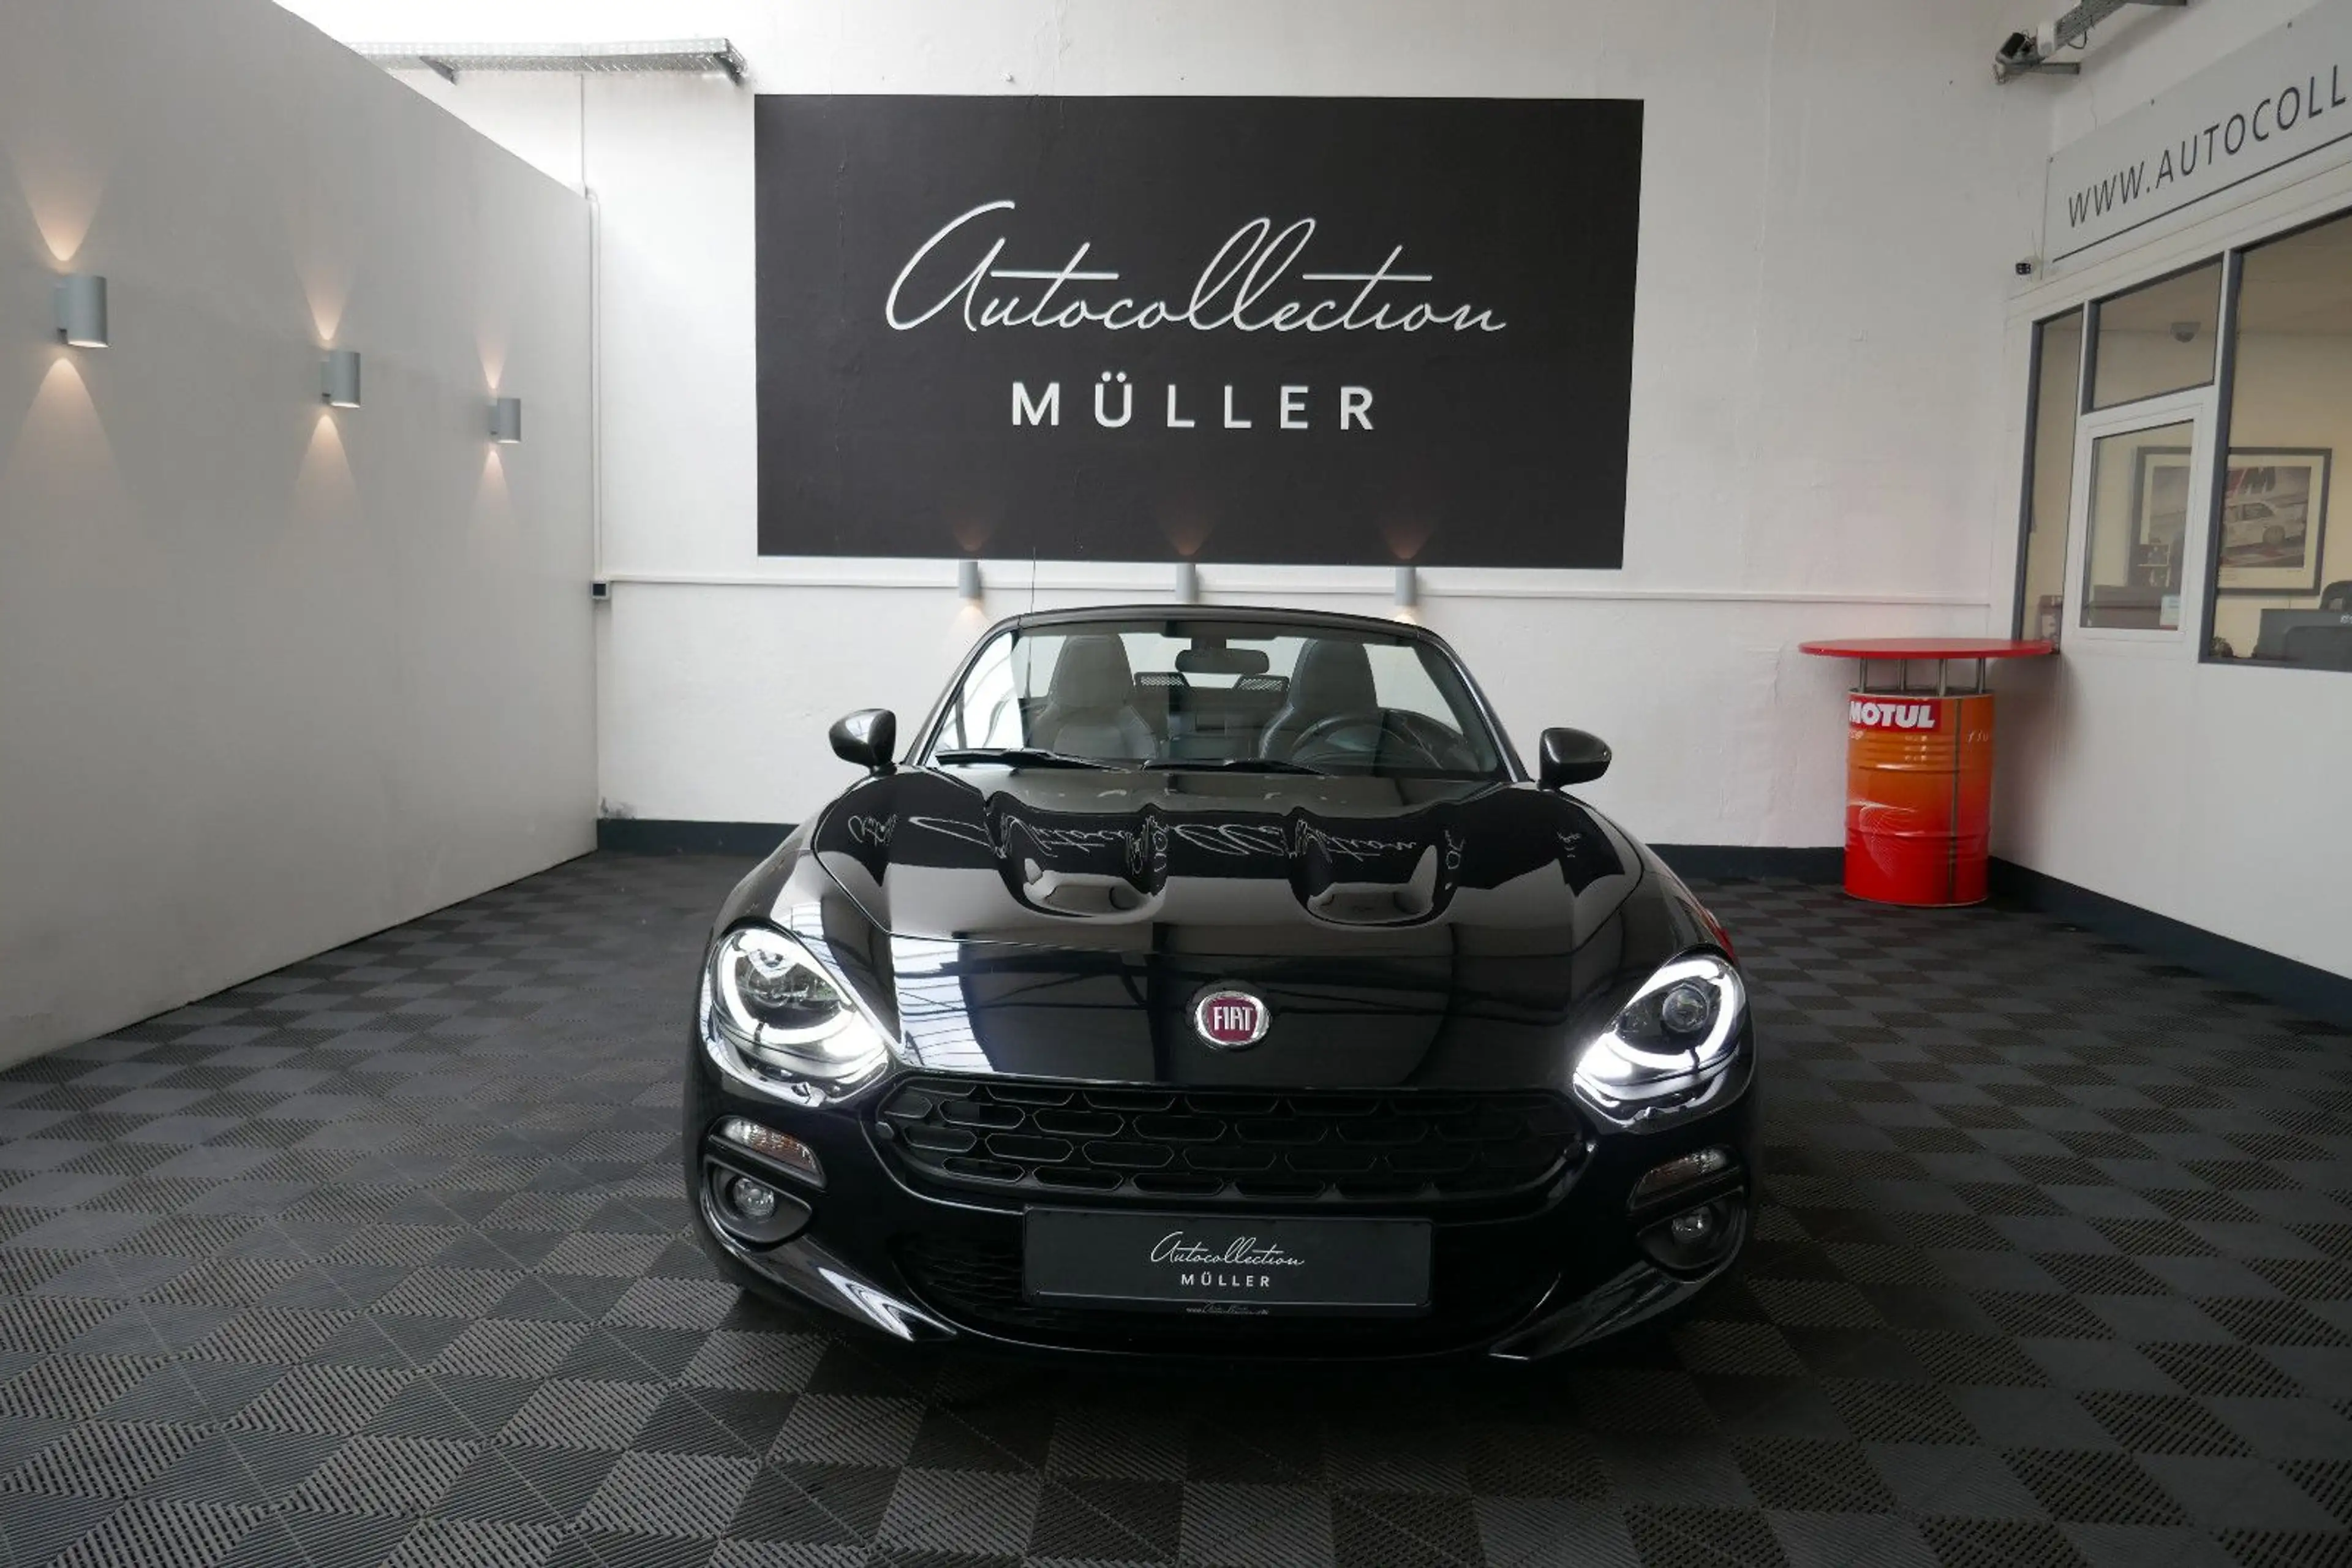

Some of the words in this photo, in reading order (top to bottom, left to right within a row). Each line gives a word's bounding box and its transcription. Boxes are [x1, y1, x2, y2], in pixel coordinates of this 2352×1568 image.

[2068, 64, 2346, 227] WWW.AUTOCOLL
[886, 201, 1506, 331] Autocollection
[1012, 372, 1374, 430] MÜLLER
[1849, 701, 1935, 728] MOTUL
[1213, 1006, 1253, 1031] FIAT
[1150, 1231, 1305, 1266] Autocollection
[1181, 1272, 1270, 1287] MÜLLER
